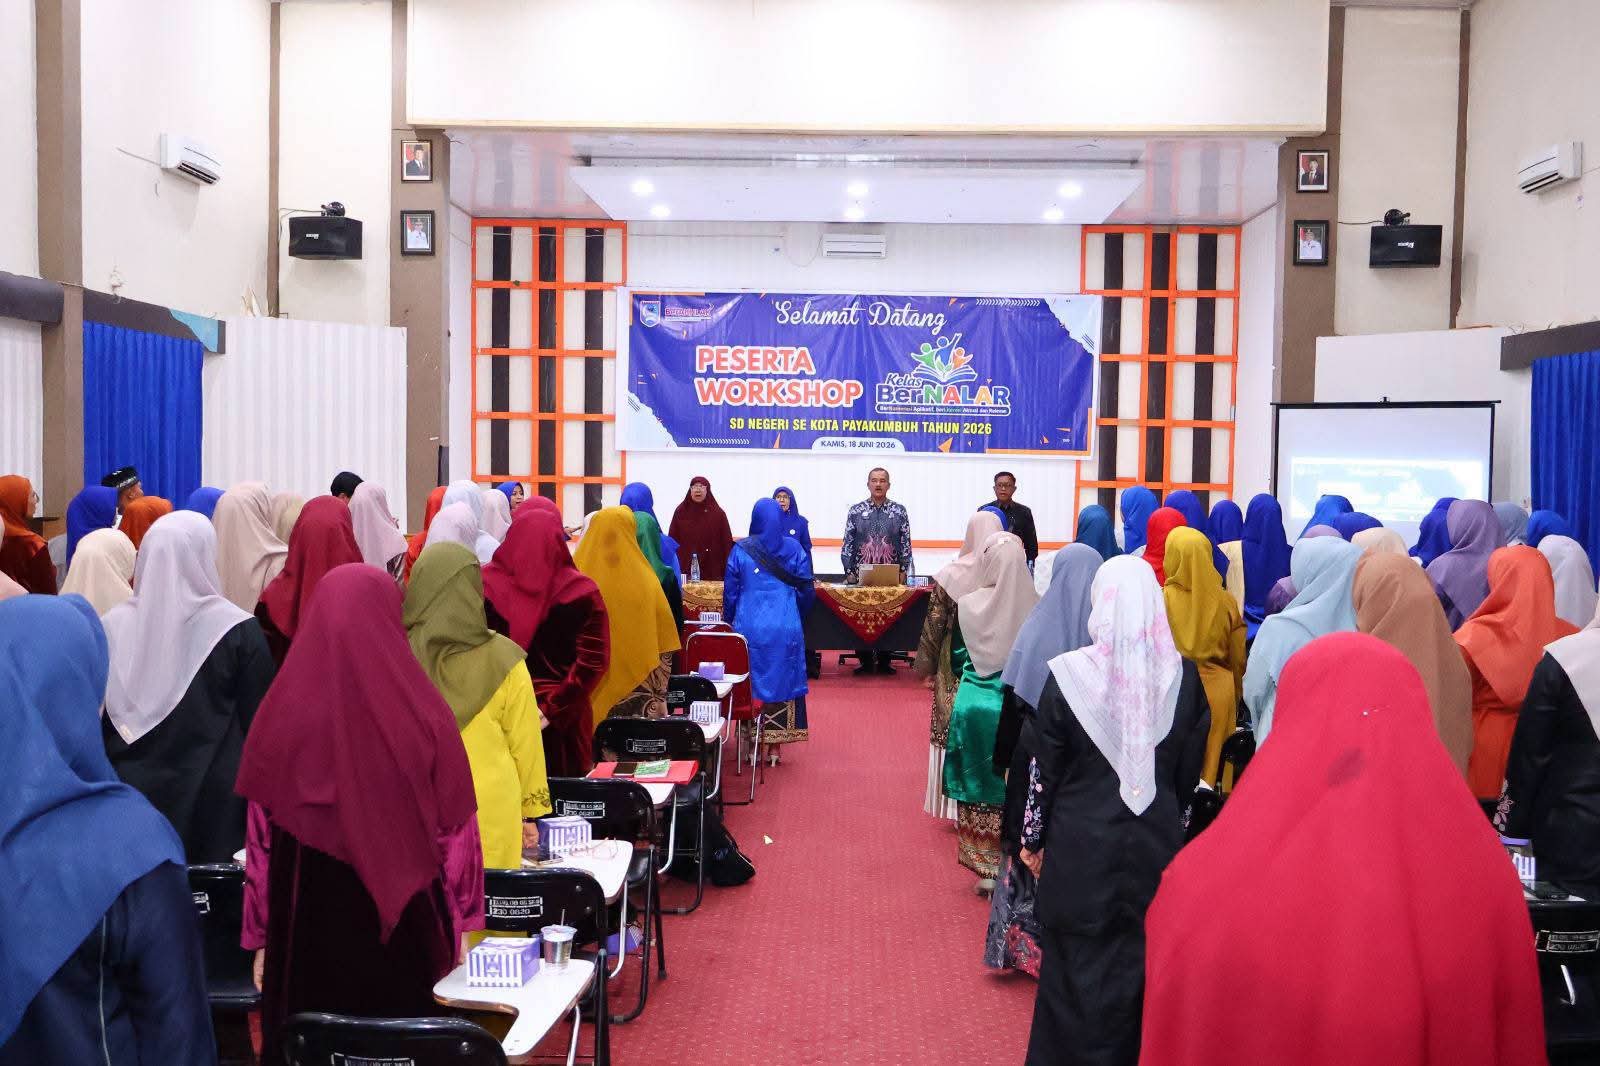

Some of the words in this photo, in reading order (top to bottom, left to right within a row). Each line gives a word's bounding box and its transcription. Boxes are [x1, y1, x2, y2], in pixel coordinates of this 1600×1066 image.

[775, 300, 866, 326] Selamat
[868, 301, 947, 335] Datang
[696, 346, 816, 375] PESERTA
[886, 373, 923, 387] Kelas
[694, 378, 863, 407] WORKSHOP
[876, 383, 1011, 406] BerNALAR
[729, 418, 744, 430] SD
[748, 418, 789, 431] NEGERI
[793, 419, 807, 431] SE
[810, 419, 839, 432] KOTA
[842, 420, 919, 433] PAYAKUMBUH
[922, 421, 960, 434] TAHUN
[963, 422, 993, 435] 2026
[820, 440, 847, 449] KAMIS,
[849, 440, 857, 448] 18
[858, 440, 874, 449] JUNI
[876, 441, 896, 449] 2026
